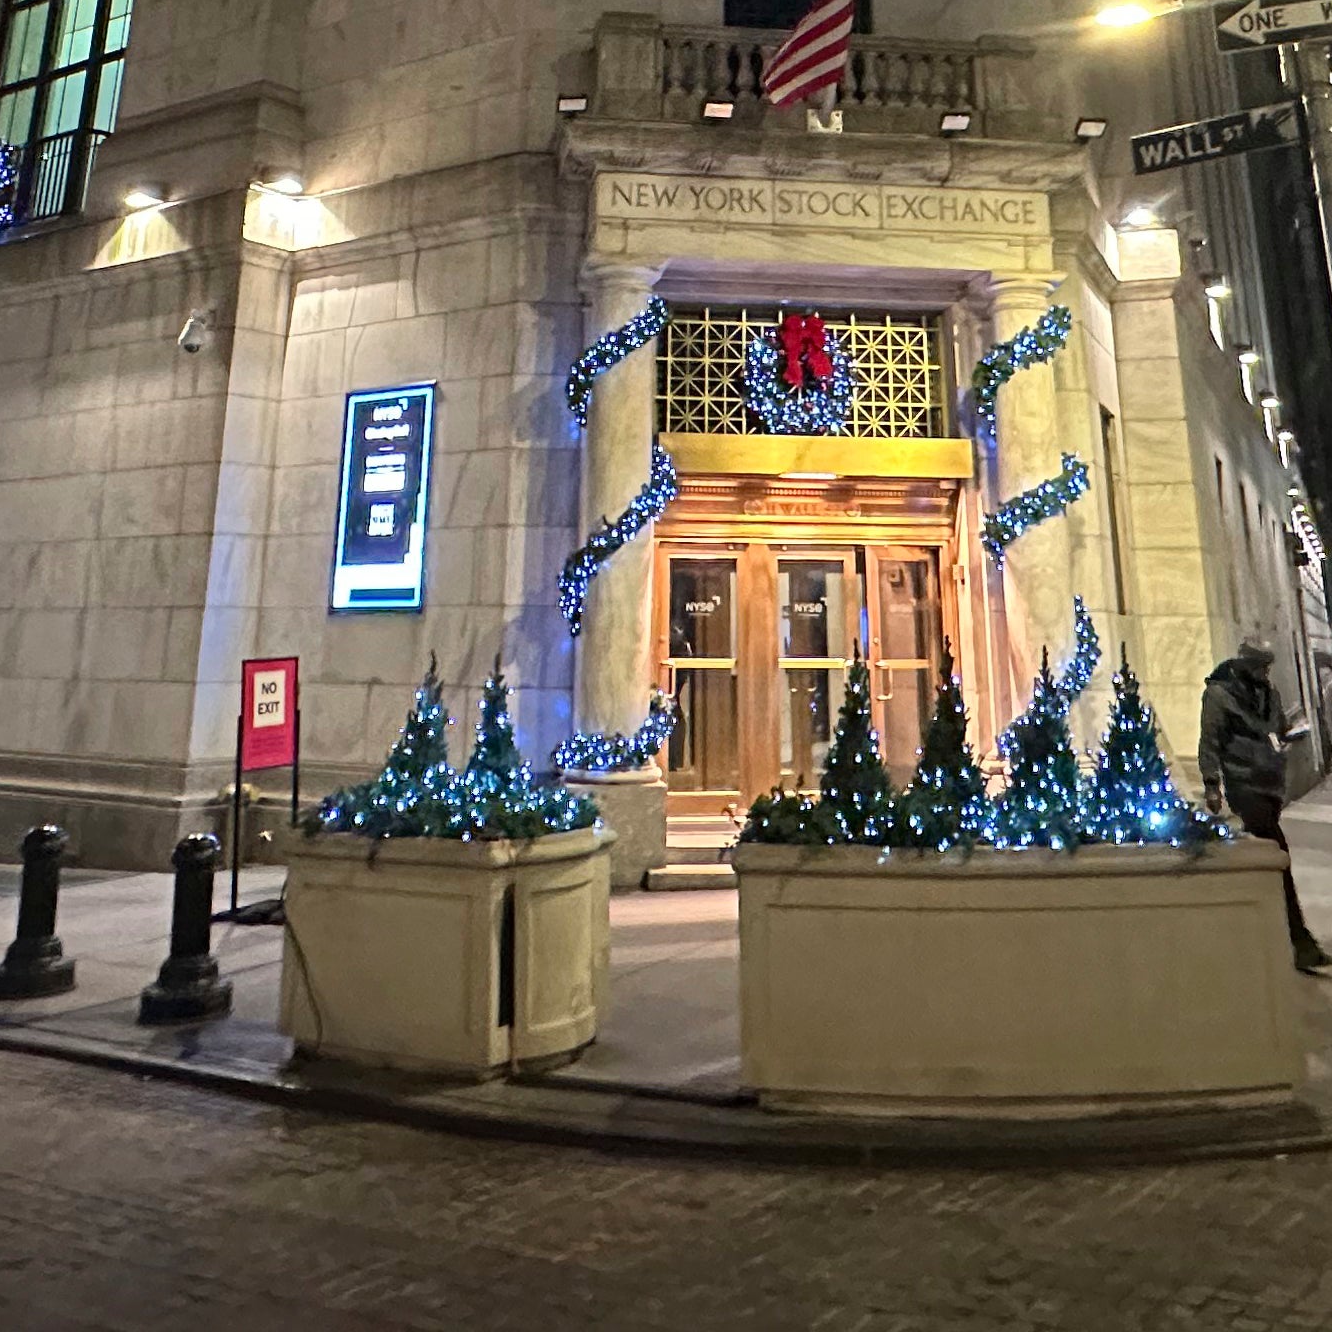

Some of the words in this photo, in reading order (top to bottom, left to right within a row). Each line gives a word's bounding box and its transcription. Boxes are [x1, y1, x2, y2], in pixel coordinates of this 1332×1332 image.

[1238, 8, 1288, 34] ONE
[1138, 130, 1223, 168] WALL
[1221, 124, 1244, 142] ST
[611, 181, 678, 207] NEW
[690, 185, 766, 213] YORK
[777, 189, 871, 219] STOCK
[885, 193, 1036, 225] EXCHANGE
[261, 682, 278, 695] NO
[257, 701, 280, 715] EXIT
